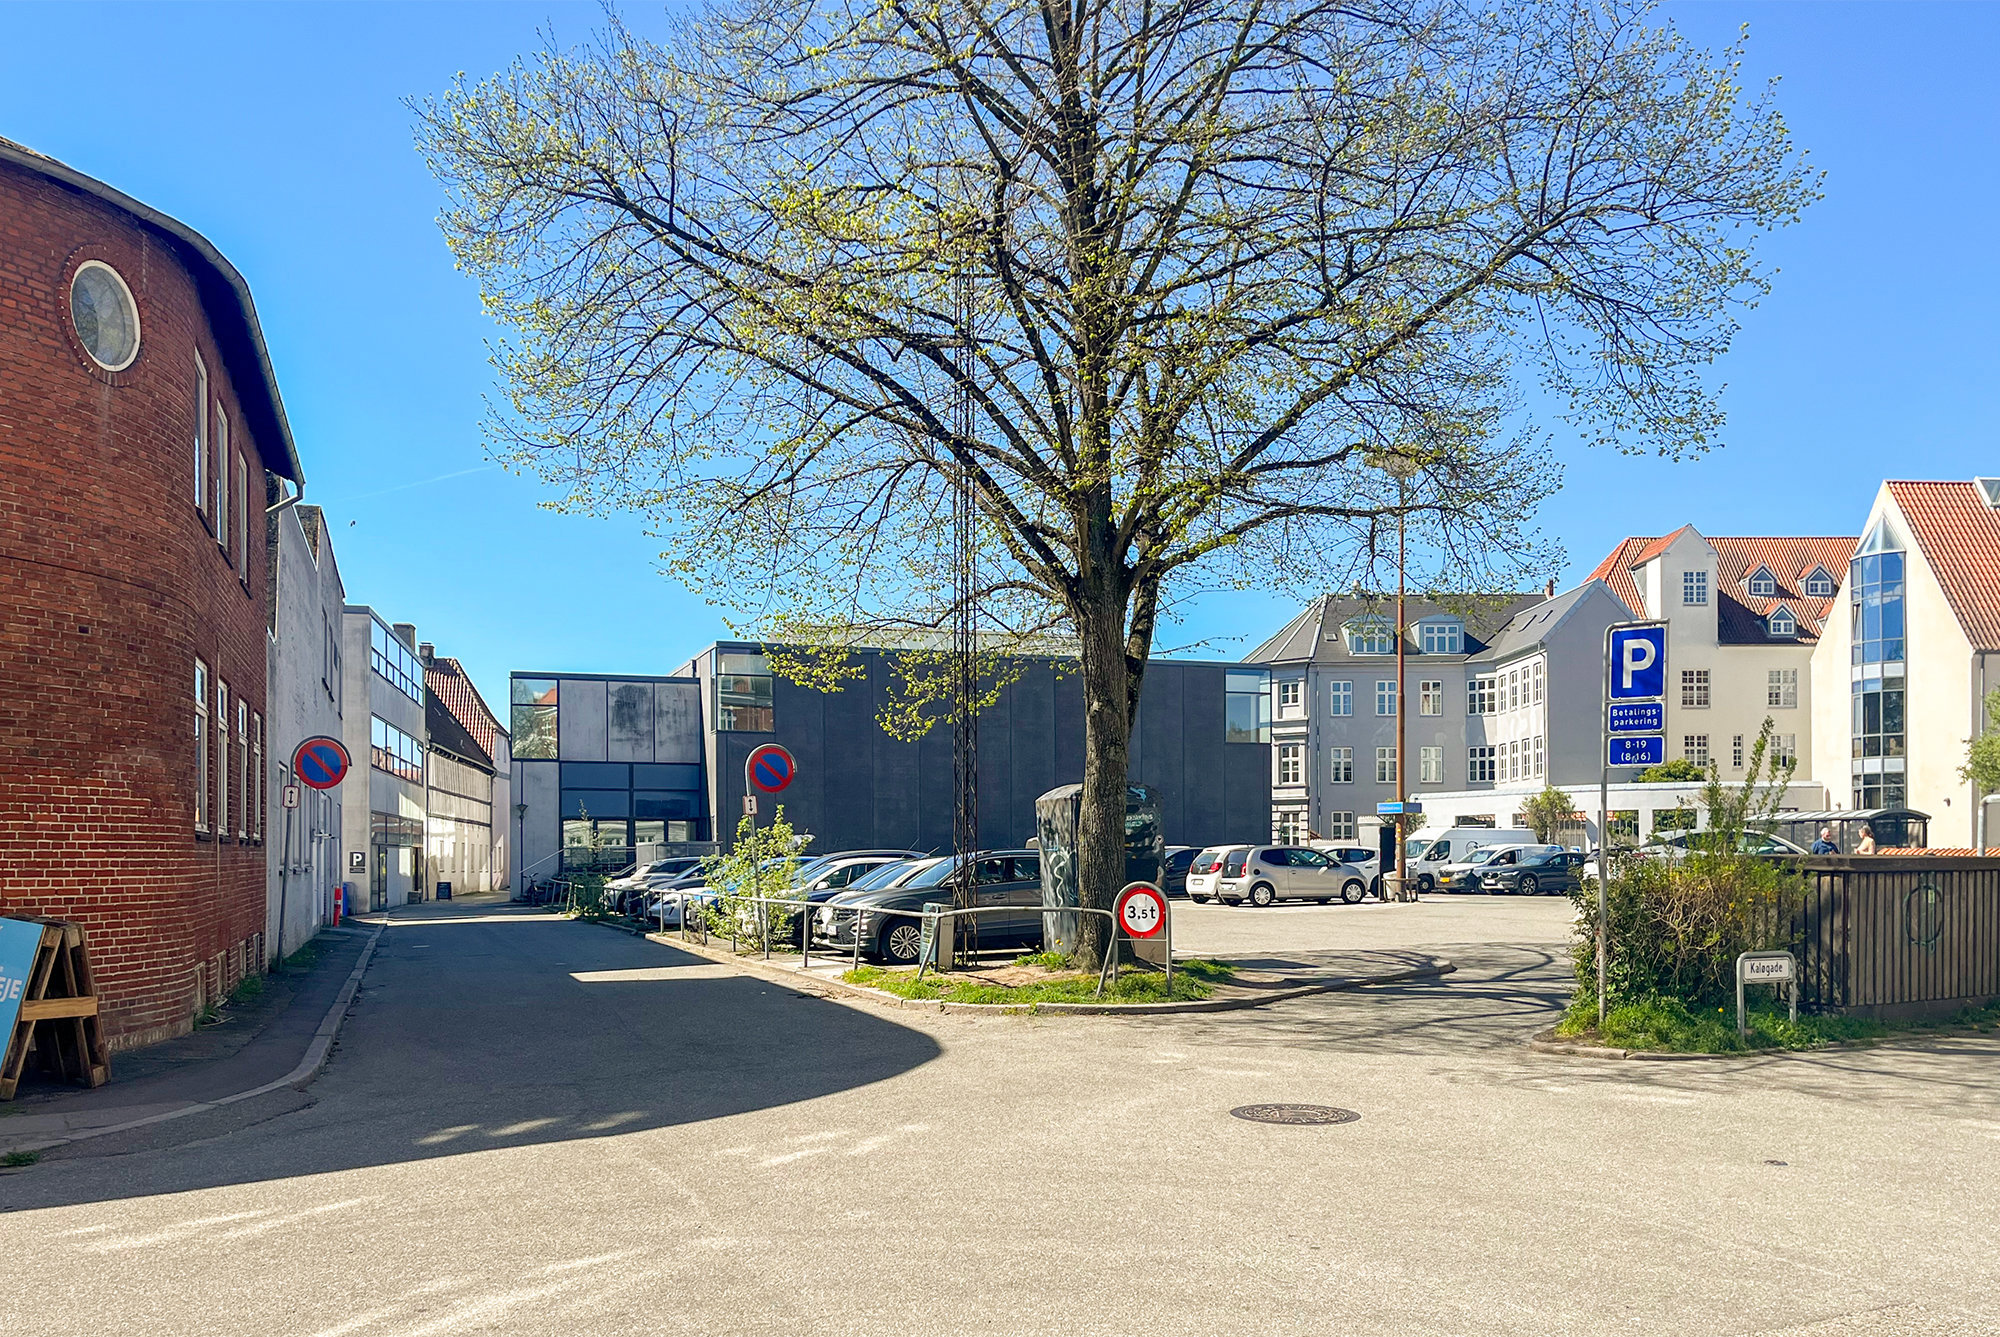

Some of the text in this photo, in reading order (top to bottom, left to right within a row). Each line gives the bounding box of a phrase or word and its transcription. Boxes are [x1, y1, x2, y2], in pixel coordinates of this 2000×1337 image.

[1622, 638, 1656, 689] P
[1613, 717, 1658, 727] parkering
[1625, 740, 1647, 749] 8-19
[352, 853, 363, 866] P
[1750, 961, 1783, 976] Kaløgade
